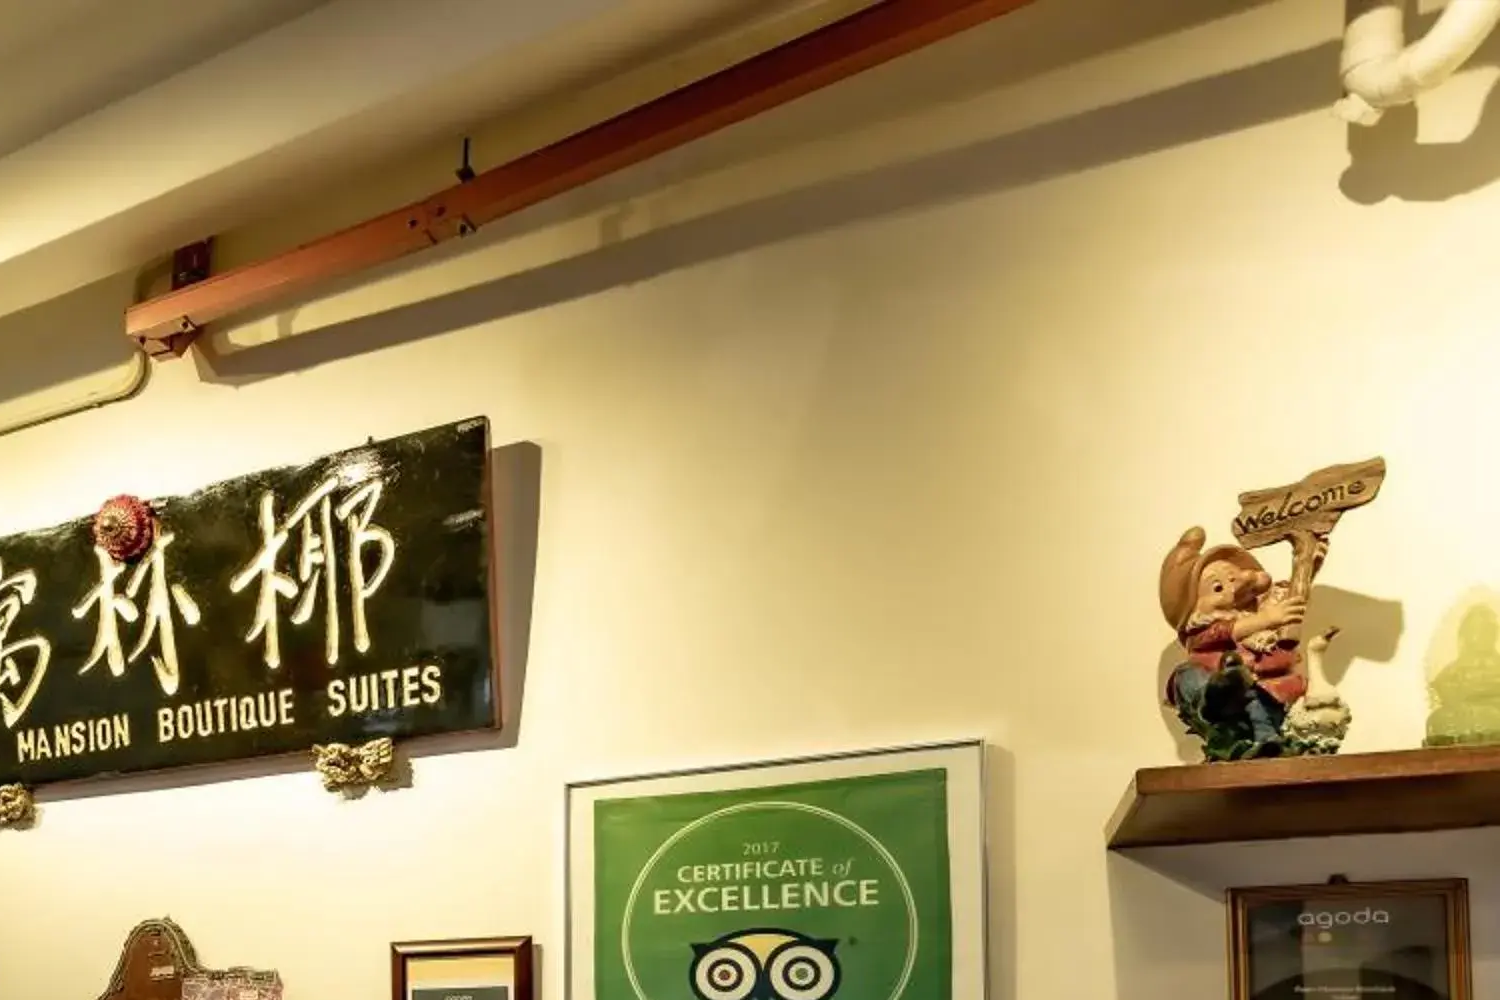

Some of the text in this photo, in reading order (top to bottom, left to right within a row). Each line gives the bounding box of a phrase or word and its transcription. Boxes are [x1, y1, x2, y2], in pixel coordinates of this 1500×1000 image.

[1235, 480, 1366, 535] Welcome
[17, 713, 131, 765] MANSION
[158, 688, 295, 744] BOUTIQUE
[327, 665, 441, 718] SUITES
[742, 842, 780, 856] 2017
[677, 858, 852, 883] CERTIFICATE of
[654, 879, 880, 915] EXCELLENCE
[1297, 907, 1389, 928] agoda
